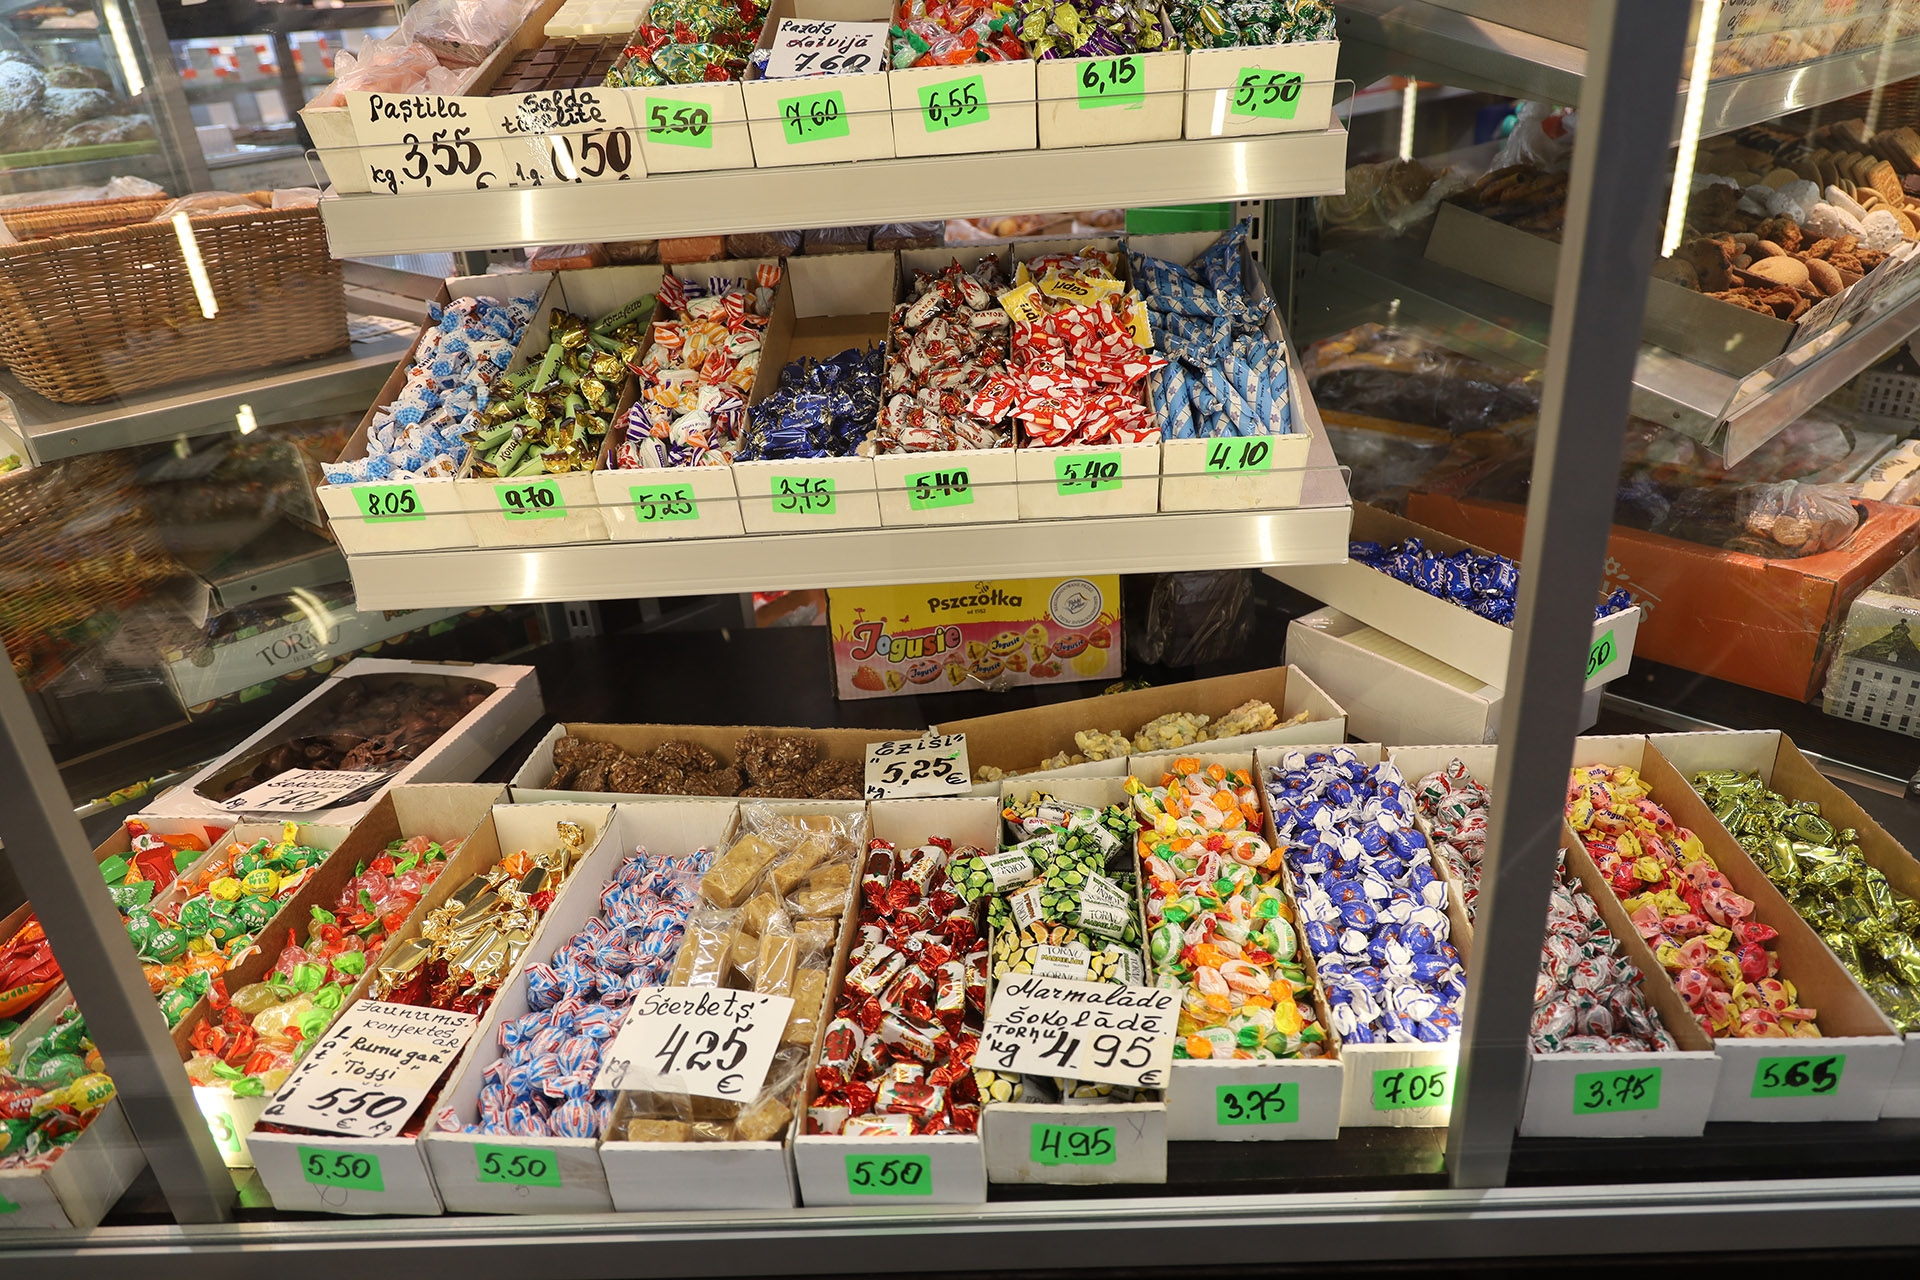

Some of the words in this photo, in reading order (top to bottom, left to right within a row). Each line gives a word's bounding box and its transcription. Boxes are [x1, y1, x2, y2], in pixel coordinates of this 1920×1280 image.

[1082, 57, 1136, 94] 6,15
[929, 83, 978, 127] 6,55
[1236, 75, 1301, 111] 5,50
[651, 105, 708, 136] 5.50
[786, 98, 838, 136] 7.60
[402, 127, 482, 187] 3,55
[1052, 280, 1088, 297] Capri
[1209, 441, 1268, 470] 4.10
[369, 489, 416, 515] 8.05
[639, 489, 693, 520] 5.25
[780, 479, 831, 514] 3,75
[851, 621, 963, 664] Jogusie
[991, 636, 1020, 650] Jogusie
[1055, 639, 1085, 652] Jogusie
[910, 664, 938, 678] Jogusie
[972, 661, 1001, 675] Jogusie
[1585, 641, 1610, 680] .50
[881, 757, 955, 785] 5,25
[945, 772, 967, 784] €
[655, 1023, 754, 1076] 4.25
[717, 1074, 744, 1094] €
[1138, 1070, 1162, 1085] €
[1383, 1071, 1448, 1105] 7.05
[336, 1118, 357, 1130] €
[1041, 1128, 1112, 1158] 4.95
[308, 1153, 370, 1181] 5.50
[483, 1152, 546, 1179] 5.50
[853, 1160, 923, 1187] 5.50
